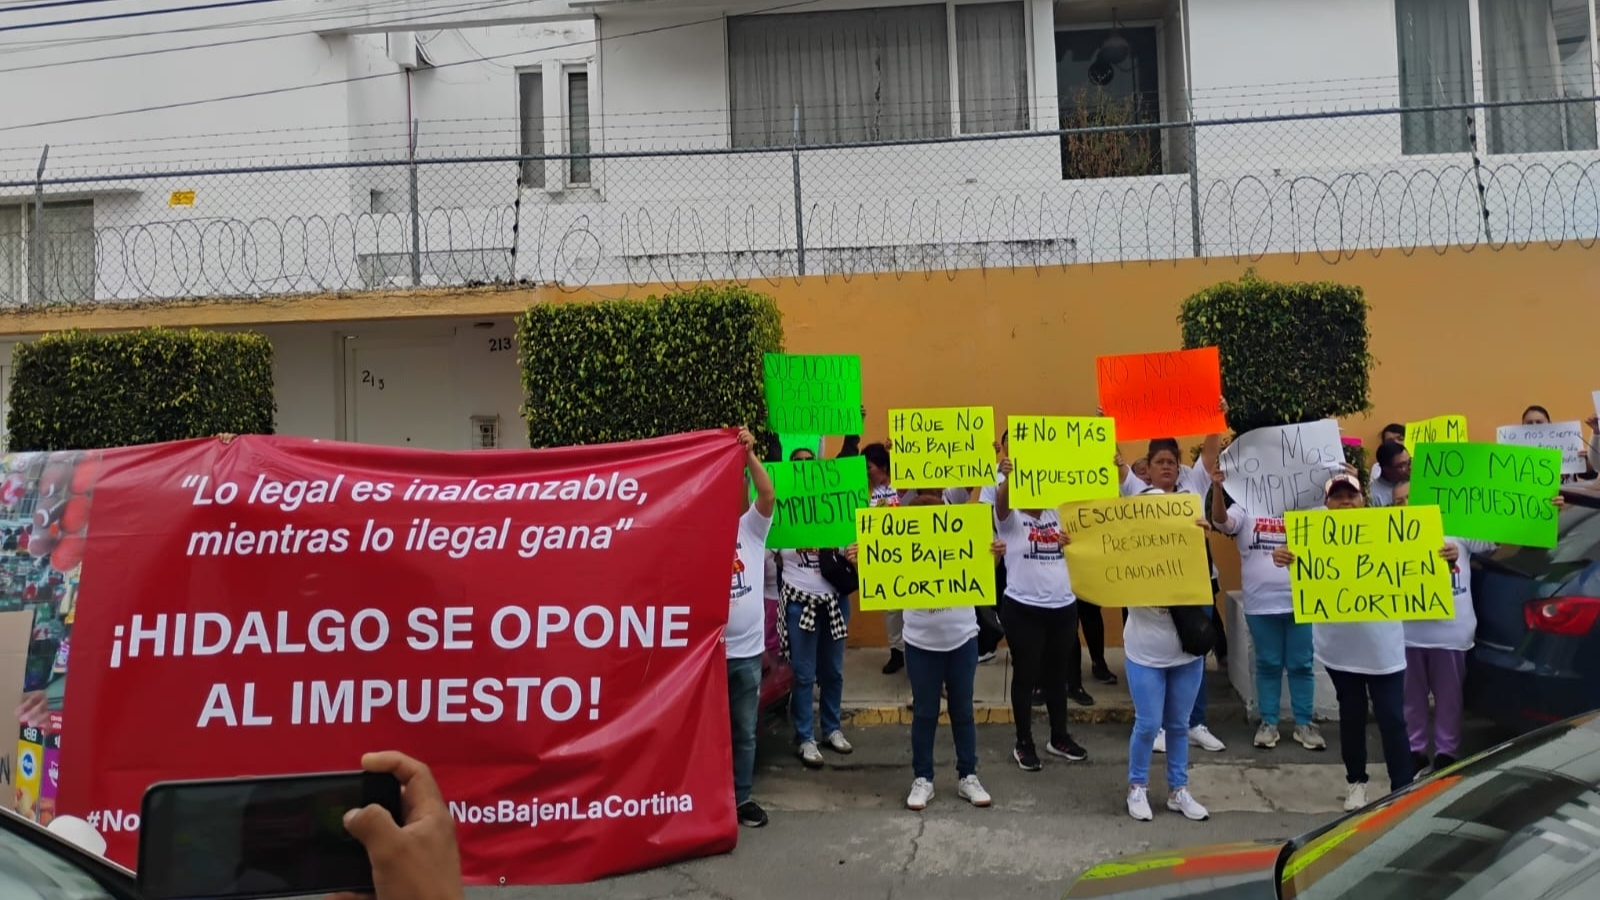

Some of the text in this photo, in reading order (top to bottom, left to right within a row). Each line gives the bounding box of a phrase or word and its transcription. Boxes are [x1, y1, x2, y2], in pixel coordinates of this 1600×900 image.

[489, 337, 512, 351] 213
[1524, 430, 1544, 439] nos
[894, 458, 996, 482] LA CORTINA
[1423, 450, 1555, 487] NO MAS
[181, 472, 648, 512] “Lo legal es inalcanzable,
[1430, 486, 1554, 521] IMPUESTOS
[185, 517, 634, 559] mientras lo ilegal gana”
[1101, 532, 1188, 554] PRESIDENTA
[862, 568, 985, 600] LA CORTINA
[1300, 583, 1450, 619] LA CORTINA
[110, 608, 390, 668] ¡HIDALGO
[406, 606, 474, 651] SE
[490, 604, 691, 650] OPONE
[196, 676, 601, 728] AL IMPUESTO!
